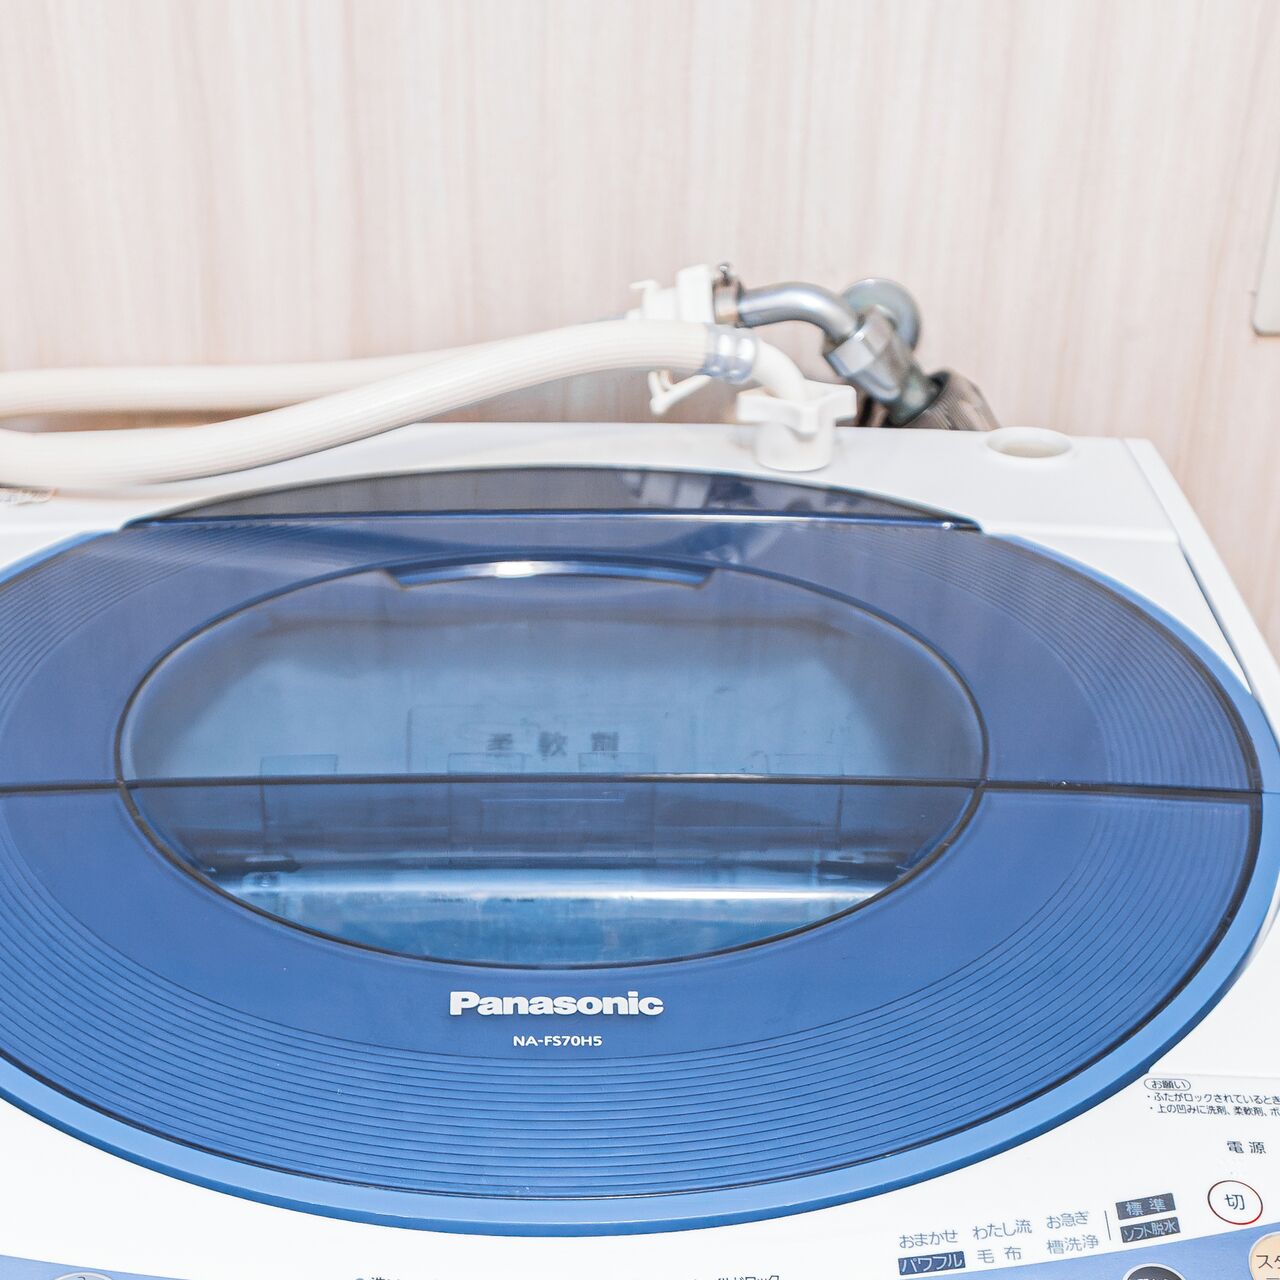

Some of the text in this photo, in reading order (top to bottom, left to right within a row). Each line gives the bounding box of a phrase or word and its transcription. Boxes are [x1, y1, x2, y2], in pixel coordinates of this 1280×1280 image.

[449, 991, 664, 1016] Panasonic
[513, 1035, 603, 1047] NA-FS70H5
[1151, 1079, 1187, 1089] お願い
[1227, 1141, 1267, 1155] 電源
[1126, 1198, 1167, 1216] 標準
[1225, 1193, 1246, 1211] 切
[898, 1210, 1090, 1249] おまかせ わたし流 お急ぎ
[1125, 1221, 1178, 1241] ソフト脱水
[900, 1234, 1100, 1273] パワフル 毛布 槽洗浄
